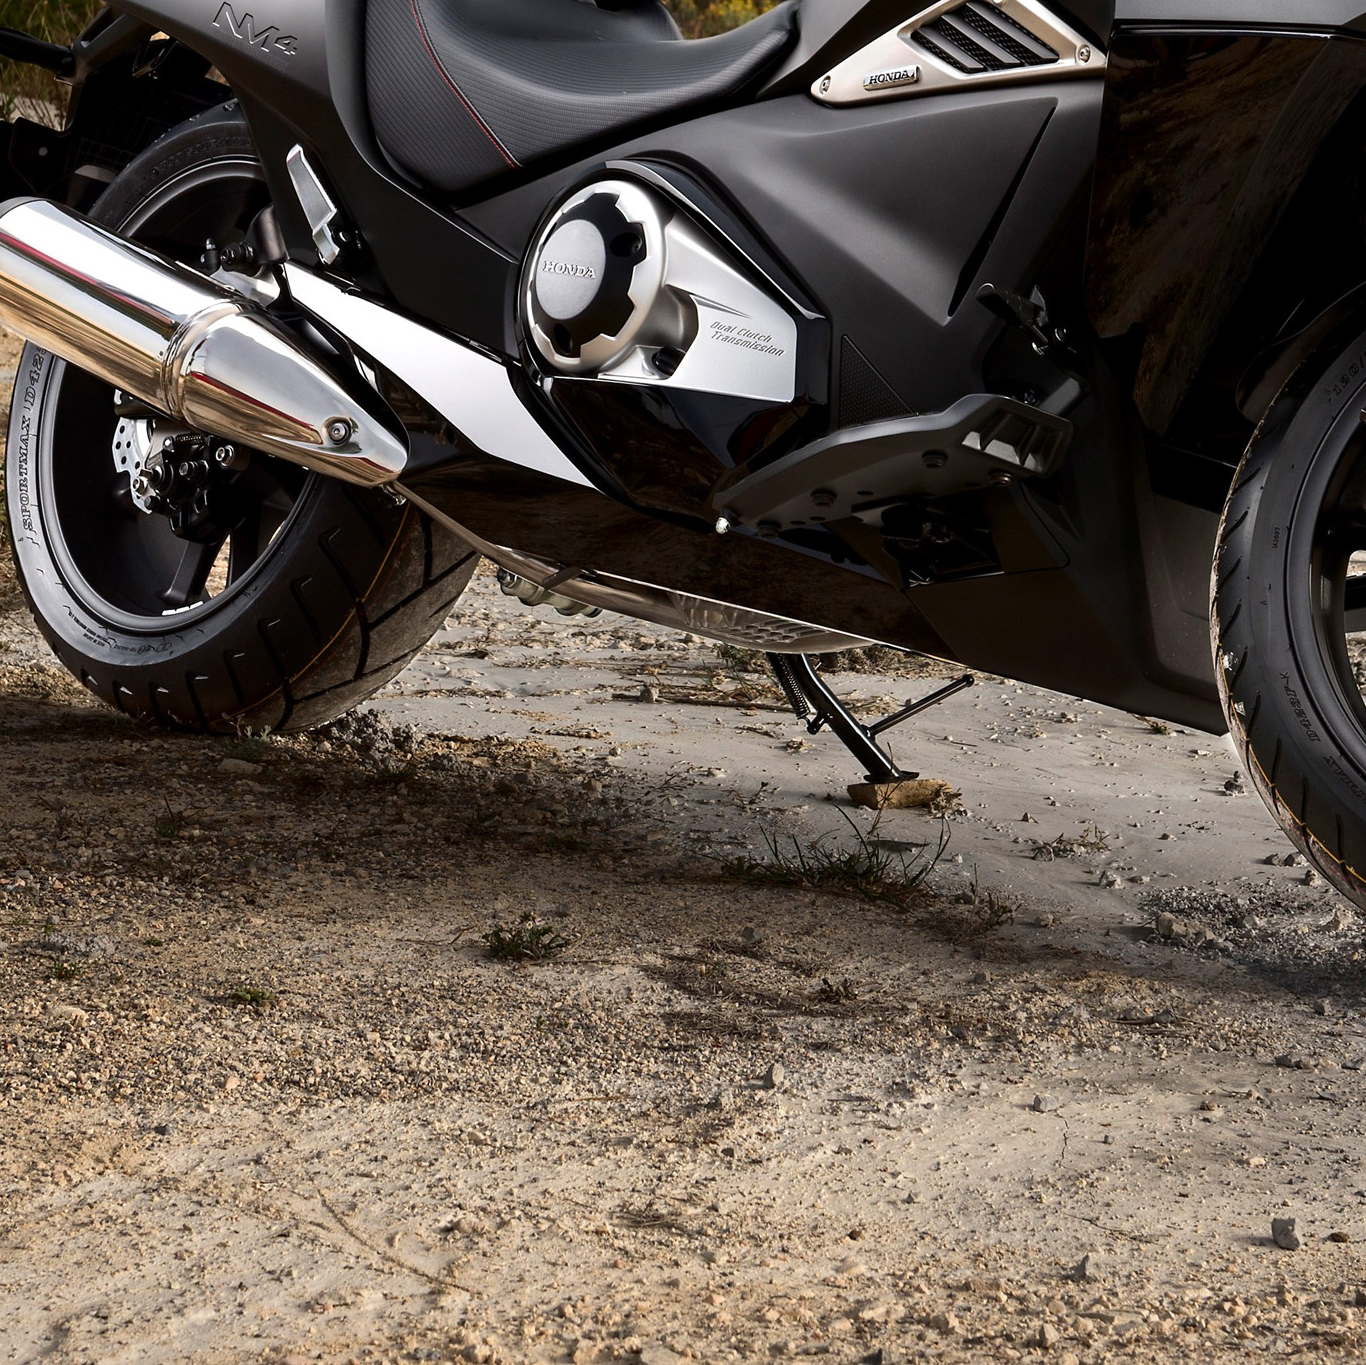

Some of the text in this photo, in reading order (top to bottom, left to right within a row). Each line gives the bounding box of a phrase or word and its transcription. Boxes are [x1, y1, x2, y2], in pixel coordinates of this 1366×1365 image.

[212, 1, 299, 56] NM4
[868, 70, 910, 85] HONDA
[542, 260, 597, 279] HONDA
[710, 321, 773, 343] Dual Clutch
[711, 330, 786, 357] Transmission
[18, 415, 32, 532] SPORTMAX
